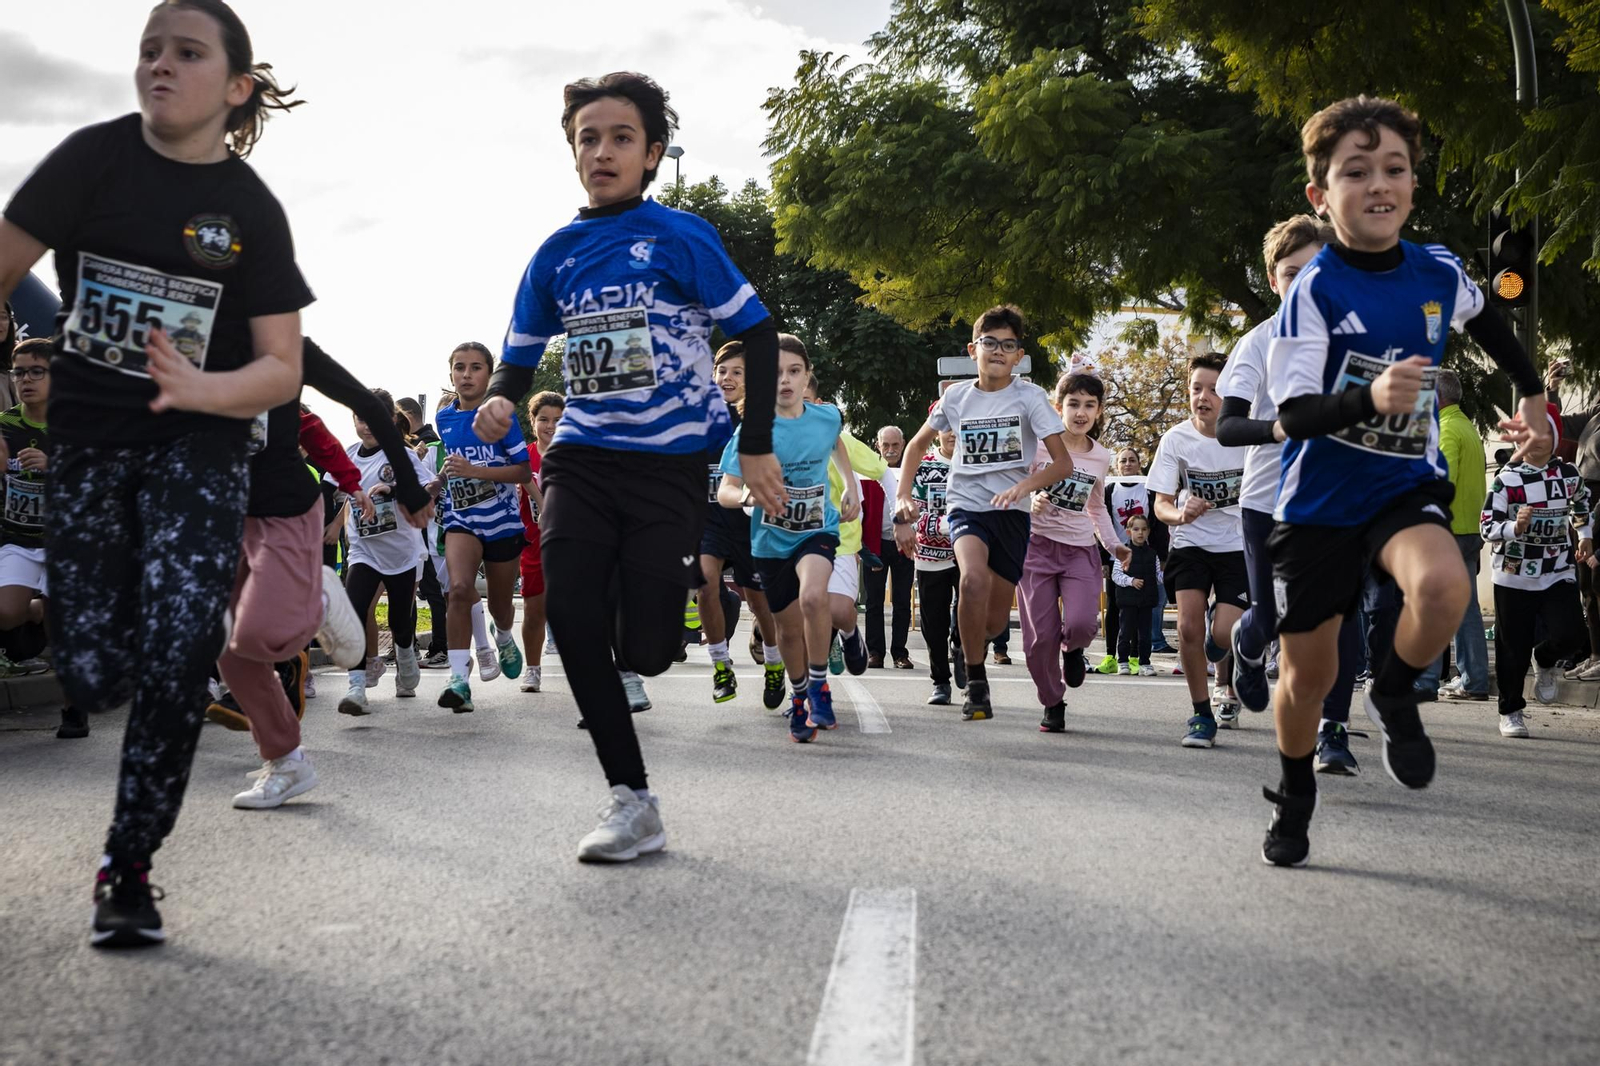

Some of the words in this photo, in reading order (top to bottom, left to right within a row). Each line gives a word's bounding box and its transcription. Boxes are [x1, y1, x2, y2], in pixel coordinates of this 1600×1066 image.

[96, 272, 150, 294] BOMBEROS
[151, 285, 166, 297] DE
[167, 289, 196, 303] JEREZ
[123, 267, 167, 287] INFANTIL
[80, 287, 164, 350] 555
[568, 337, 616, 377] 562
[965, 431, 998, 454] 527
[450, 478, 476, 501] 565
[1191, 481, 1229, 501] 533
[1550, 480, 1564, 499] A
[10, 491, 39, 515] 521
[781, 501, 807, 521] 50
